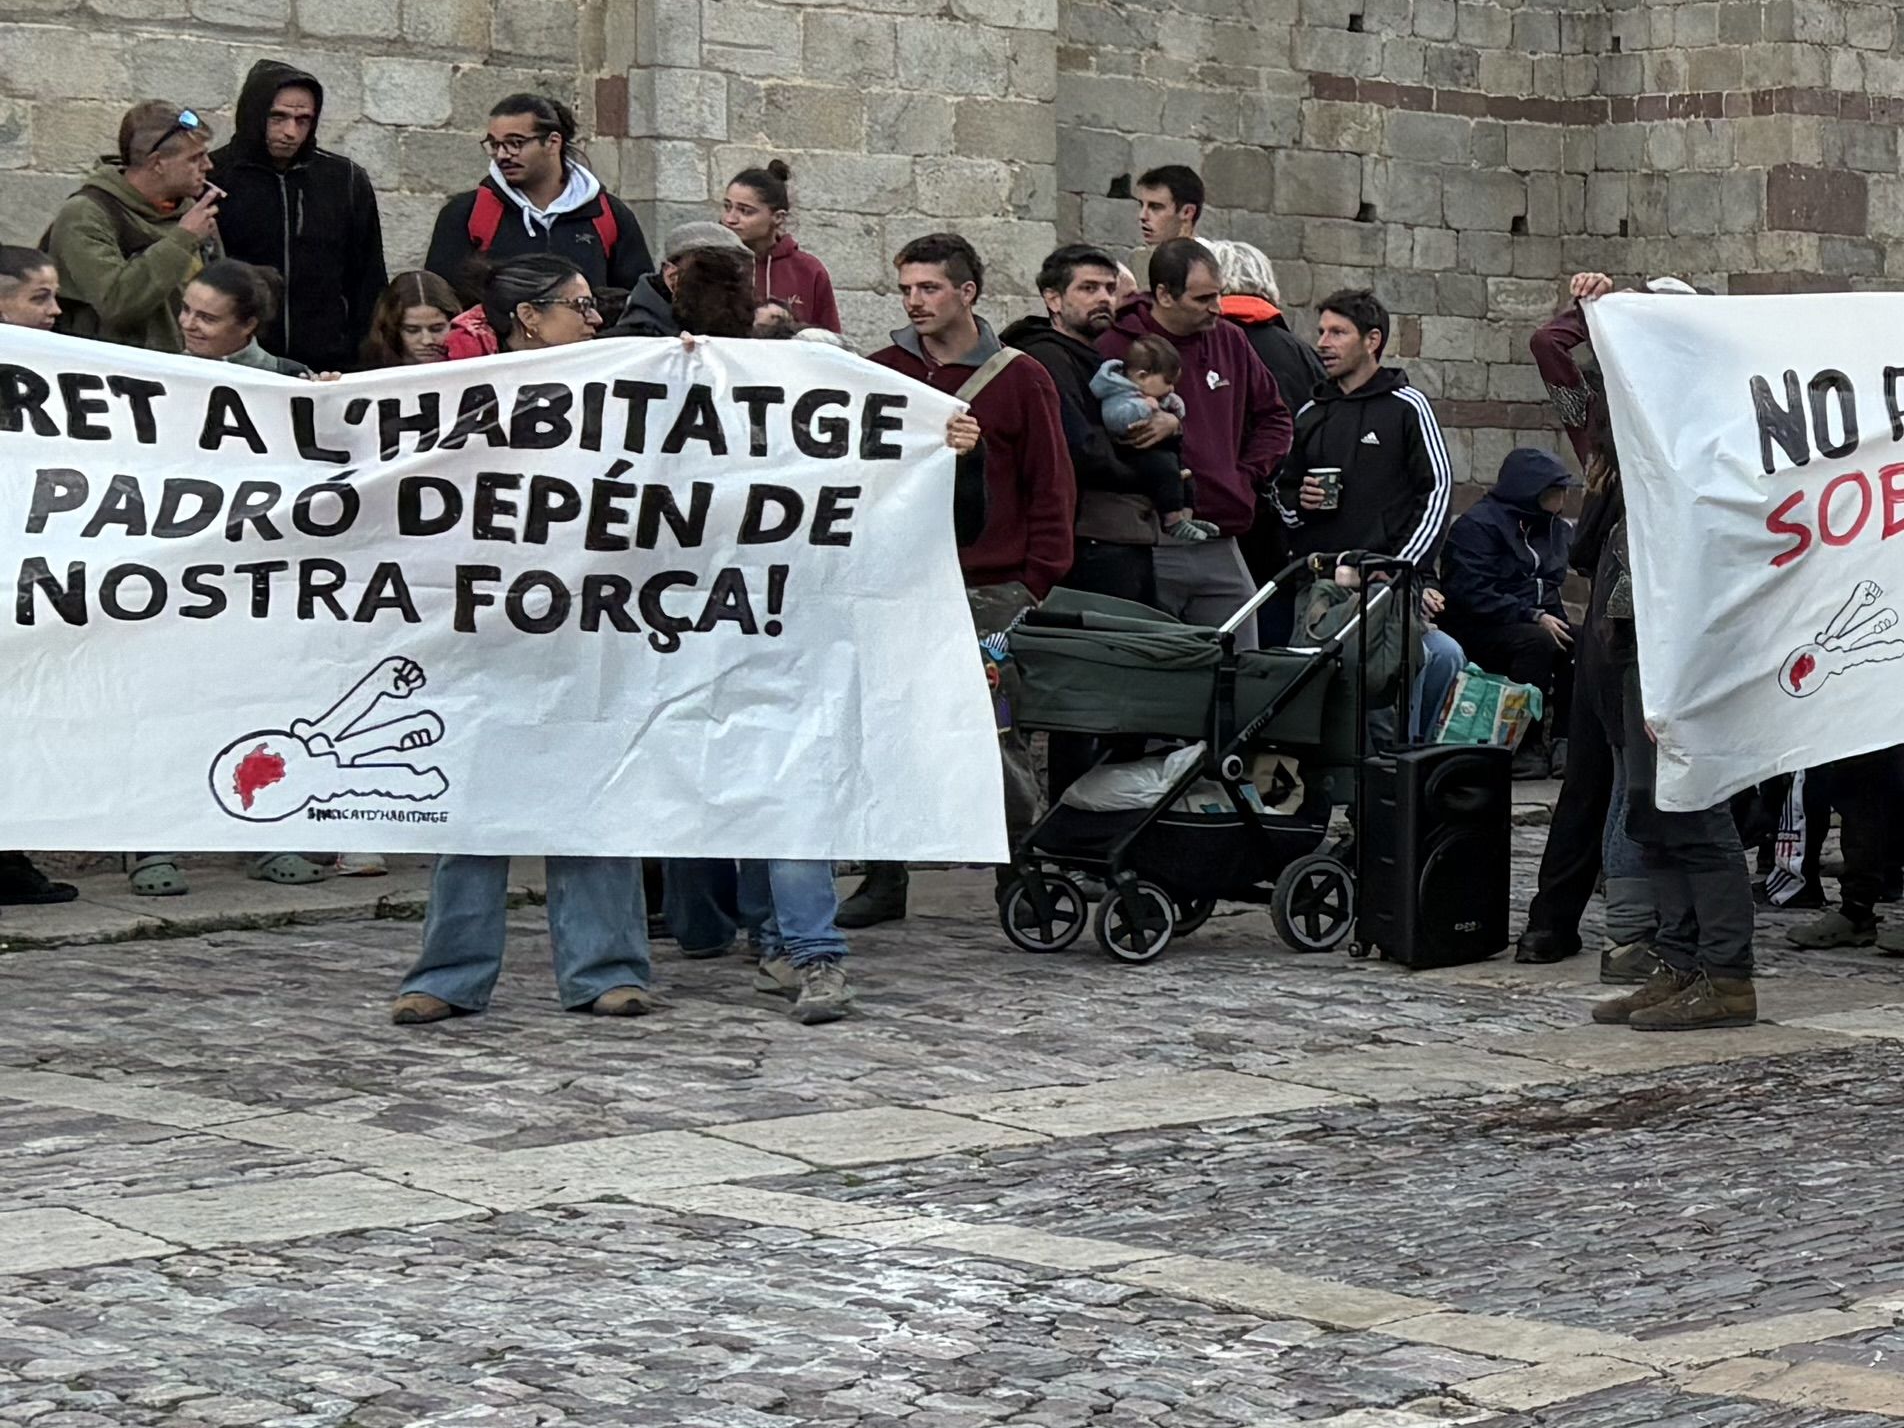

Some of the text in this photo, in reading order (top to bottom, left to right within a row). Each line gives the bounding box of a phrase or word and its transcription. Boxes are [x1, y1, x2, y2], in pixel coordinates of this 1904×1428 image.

[200, 383, 269, 454] A
[291, 378, 909, 466] L'HABITATGE
[1751, 369, 1858, 475] NO
[24, 458, 864, 551] PADRÓ DEPÉN DE
[15, 556, 792, 654] NOSTRA FORÇA!
